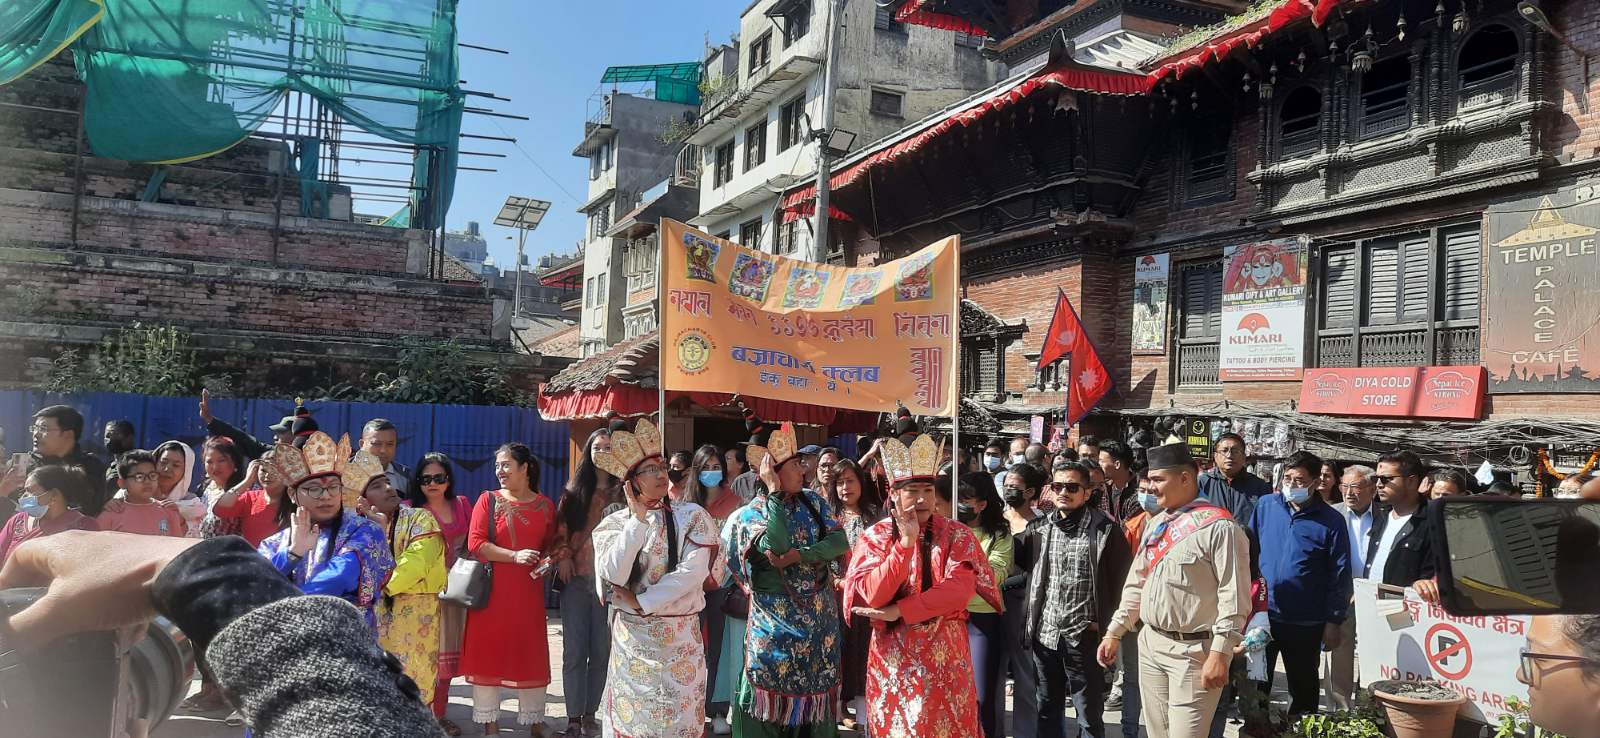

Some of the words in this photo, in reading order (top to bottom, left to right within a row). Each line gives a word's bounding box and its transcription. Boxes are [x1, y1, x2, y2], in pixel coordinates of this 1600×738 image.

[1500, 239, 1595, 264] TEMPLE
[1223, 293, 1245, 302] KUMARI
[1245, 290, 1259, 300] GIFT
[1265, 289, 1277, 298] ART
[1278, 286, 1305, 297] GALLERY
[1534, 266, 1556, 343] PALACE
[1229, 334, 1282, 344] KUMARI
[1268, 356, 1296, 364] PIERCING
[822, 366, 881, 383] क्लब
[1354, 377, 1378, 389] DIYA
[1380, 376, 1412, 389] COLD
[1362, 395, 1398, 406] STORE
[1380, 664, 1401, 680] NO
[1481, 690, 1528, 714] ARE
